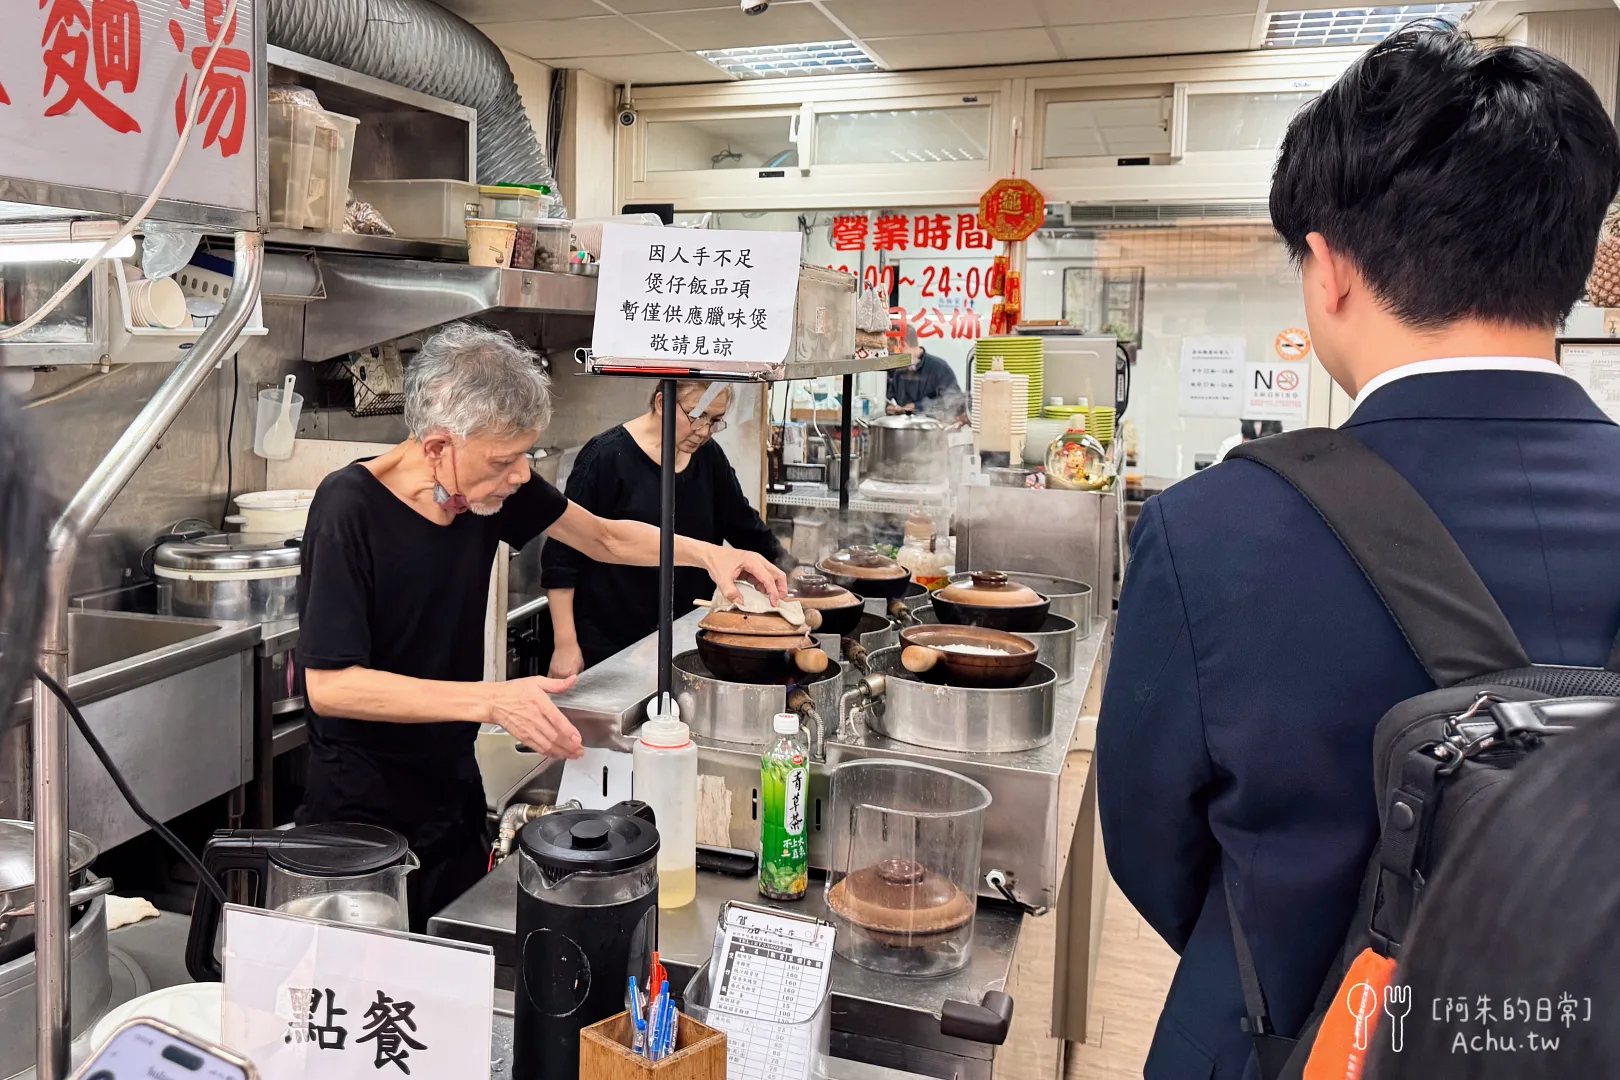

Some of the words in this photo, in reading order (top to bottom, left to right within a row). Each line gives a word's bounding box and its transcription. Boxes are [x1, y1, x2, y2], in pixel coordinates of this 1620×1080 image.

[833, 213, 993, 251] 營業時間
[648, 244, 754, 269] 因人手不足
[644, 272, 752, 299] 煲仔飯品項
[620, 299, 768, 330] 暫僅供應臘味煲
[650, 333, 734, 357] 敬請見諒
[789, 769, 804, 831] 青草茶
[779, 1010, 791, 1018] 100
[284, 987, 429, 1076] 點餐
